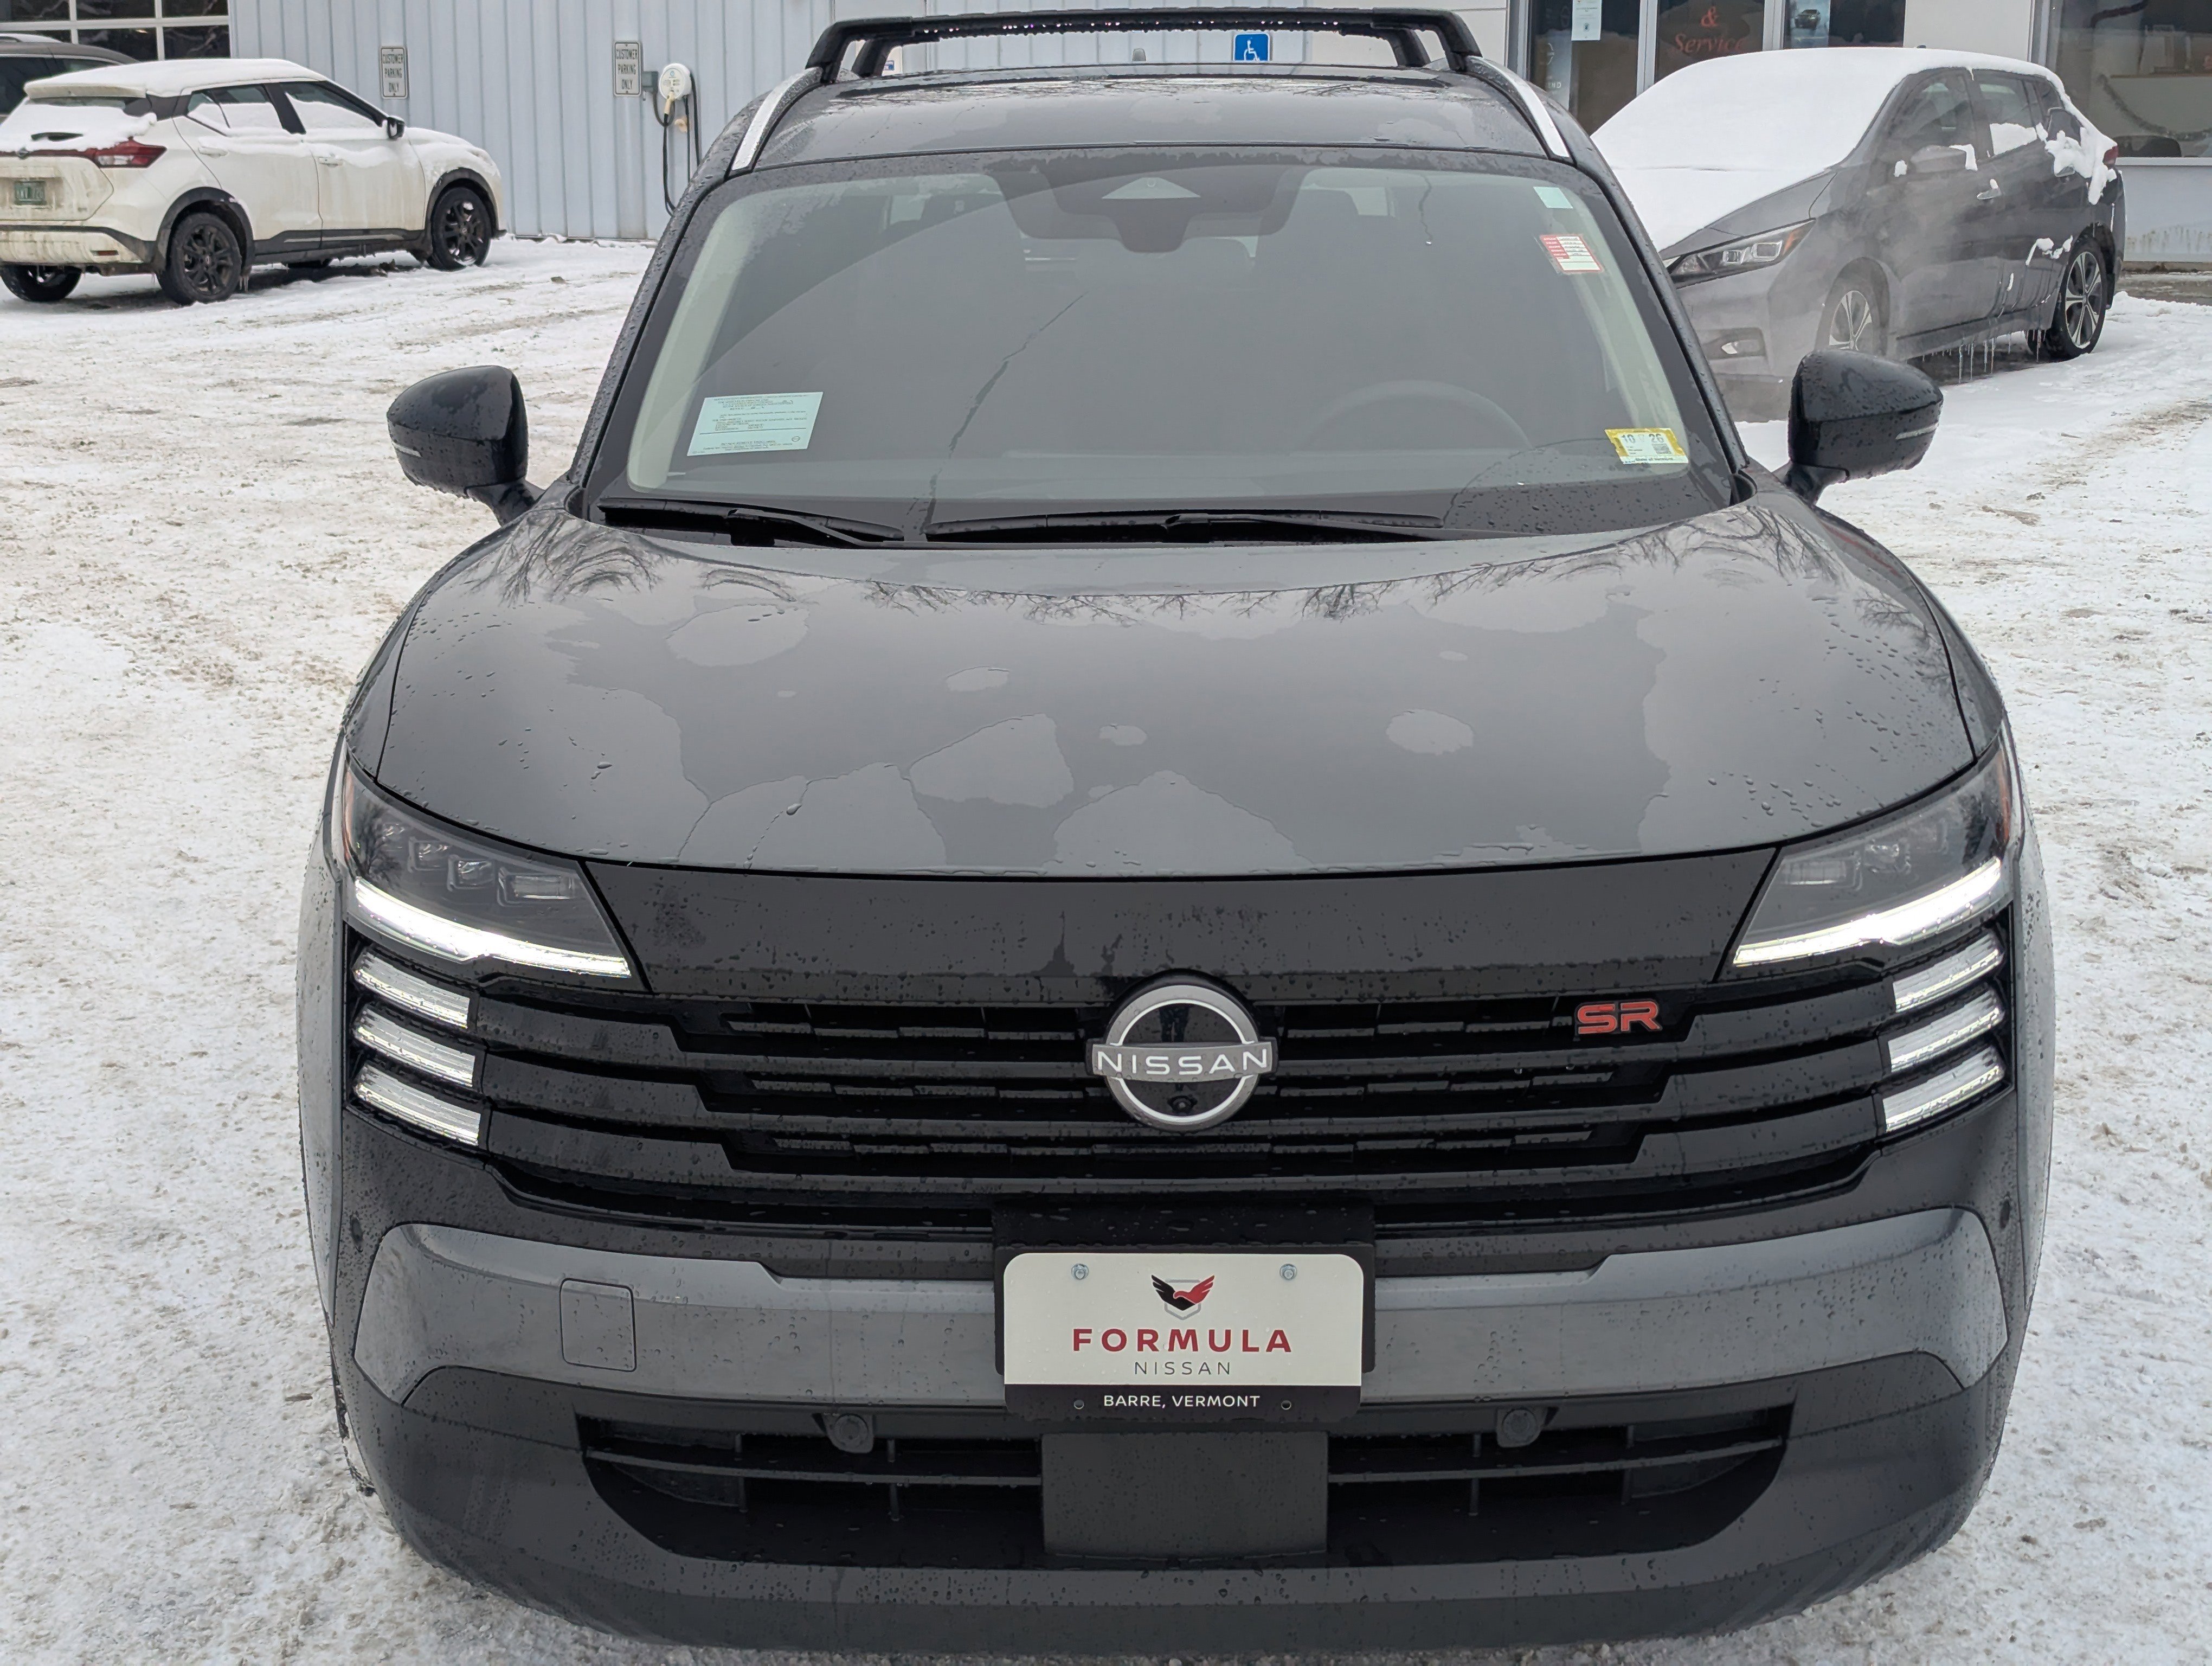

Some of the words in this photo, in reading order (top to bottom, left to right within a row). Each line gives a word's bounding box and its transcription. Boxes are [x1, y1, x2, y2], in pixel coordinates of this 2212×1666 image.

[1701, 6, 1720, 27] &
[1675, 33, 1747, 53] Service
[382, 54, 403, 64] CUSTOMER
[616, 49, 638, 60] CUSTOMER
[384, 68, 402, 78] PARKING
[618, 64, 636, 75] PARKING
[388, 82, 400, 92] ONLY
[621, 79, 633, 90] ONLY
[1621, 434, 1636, 444] 10
[1648, 433, 1664, 443] 26
[1577, 1001, 1661, 1035] SR
[1097, 1048, 1267, 1075] NISSAN
[1073, 1329, 1292, 1353] FORMULA
[1135, 1361, 1231, 1375] NISSAN
[1104, 1395, 1166, 1408] BARRE,
[1172, 1395, 1261, 1408] VERMONT
